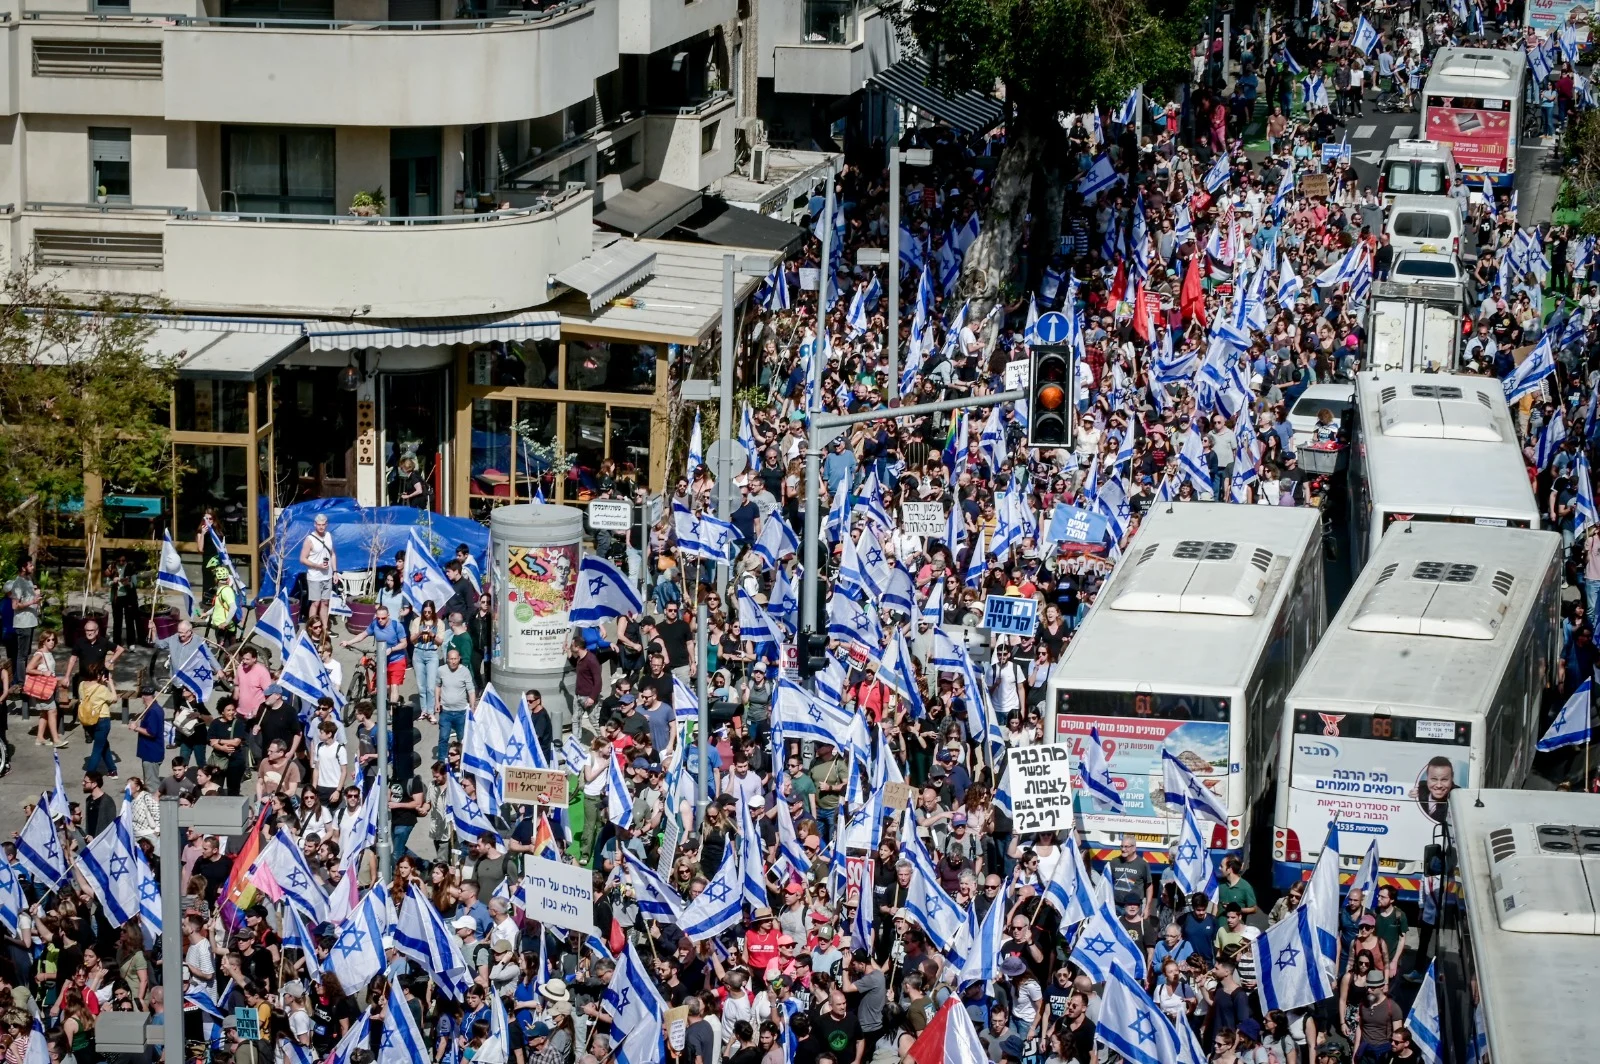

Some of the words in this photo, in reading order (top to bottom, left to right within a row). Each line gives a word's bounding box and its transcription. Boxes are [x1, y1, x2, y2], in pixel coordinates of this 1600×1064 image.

[1074, 510, 1088, 521] לא
[1066, 518, 1090, 532] צופים
[1065, 527, 1087, 541] מהצד
[986, 613, 1031, 632] קרטיה
[1135, 694, 1153, 715] 61
[1060, 719, 1085, 731] מוקדם
[1116, 723, 1135, 734] חכם!
[1135, 725, 1166, 736] מזמינים
[1066, 736, 1117, 763] $49
[1130, 742, 1155, 751] חופשות
[1298, 745, 1331, 757] מכבי
[1011, 748, 1040, 765] כבר
[1041, 747, 1068, 762] מה
[547, 771, 564, 782] בלי
[1019, 764, 1051, 777] אפשר
[1332, 769, 1366, 782] הרבה
[1369, 772, 1389, 783] הכי
[519, 781, 547, 792] ישראל
[549, 785, 564, 797] אין
[1024, 777, 1067, 795] לצפות
[1315, 779, 1361, 792] מומחים
[1362, 783, 1405, 796] רופאים
[1014, 799, 1035, 811] בשם
[1035, 794, 1071, 809] מאדם
[1317, 798, 1353, 809] הבריאות
[1355, 801, 1389, 812] סטנדרט
[1015, 809, 1060, 831] יריב?
[1363, 812, 1389, 821] הגבוה
[525, 874, 546, 888] הדור
[548, 876, 560, 891] על
[562, 884, 591, 901] נפלתם
[560, 901, 579, 916] הלא
